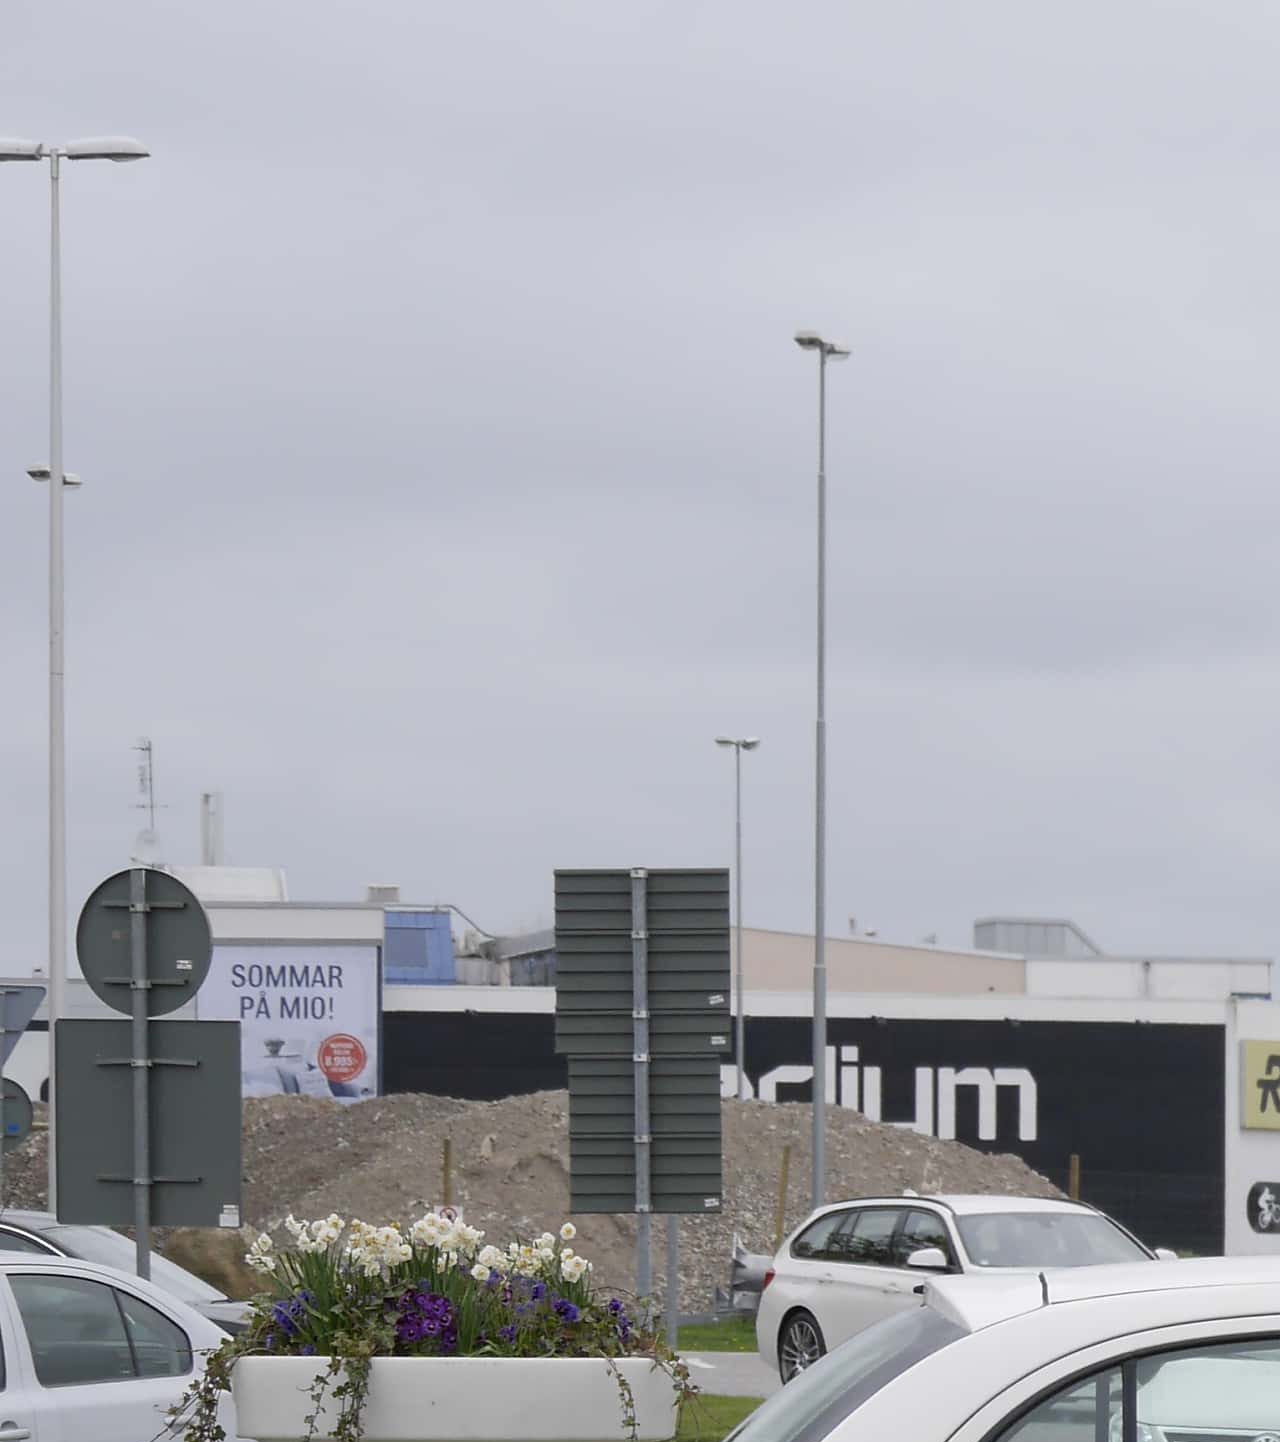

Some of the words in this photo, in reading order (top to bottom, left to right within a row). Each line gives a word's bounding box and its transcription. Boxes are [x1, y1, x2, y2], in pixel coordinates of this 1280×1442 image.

[231, 964, 343, 988] SOMMAR
[240, 991, 271, 1019] PÅ
[280, 996, 334, 1020] MIO!
